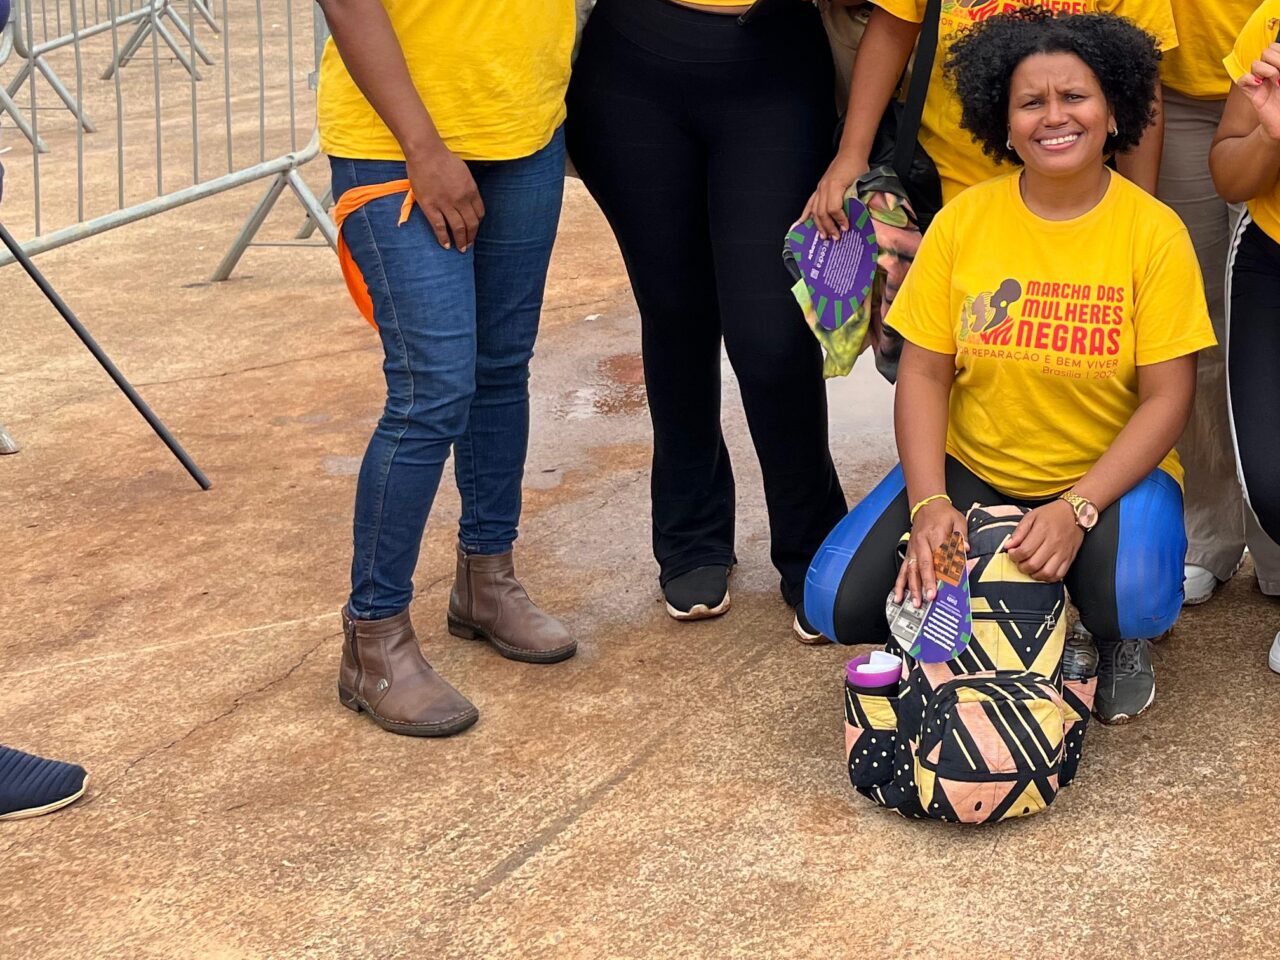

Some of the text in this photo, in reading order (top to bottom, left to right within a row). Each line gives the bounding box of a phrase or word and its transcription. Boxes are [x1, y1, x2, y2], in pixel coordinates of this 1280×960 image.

[1025, 280, 1125, 303] MARCHA DAS
[1021, 299, 1123, 326] MULHERES
[1015, 320, 1121, 356] NEGRAS
[972, 348, 1040, 362] REPARAÇÃO
[1045, 355, 1051, 364] E
[1056, 357, 1082, 368] BEM
[1087, 359, 1119, 369] VIVER
[1093, 370, 1117, 380] 2025
